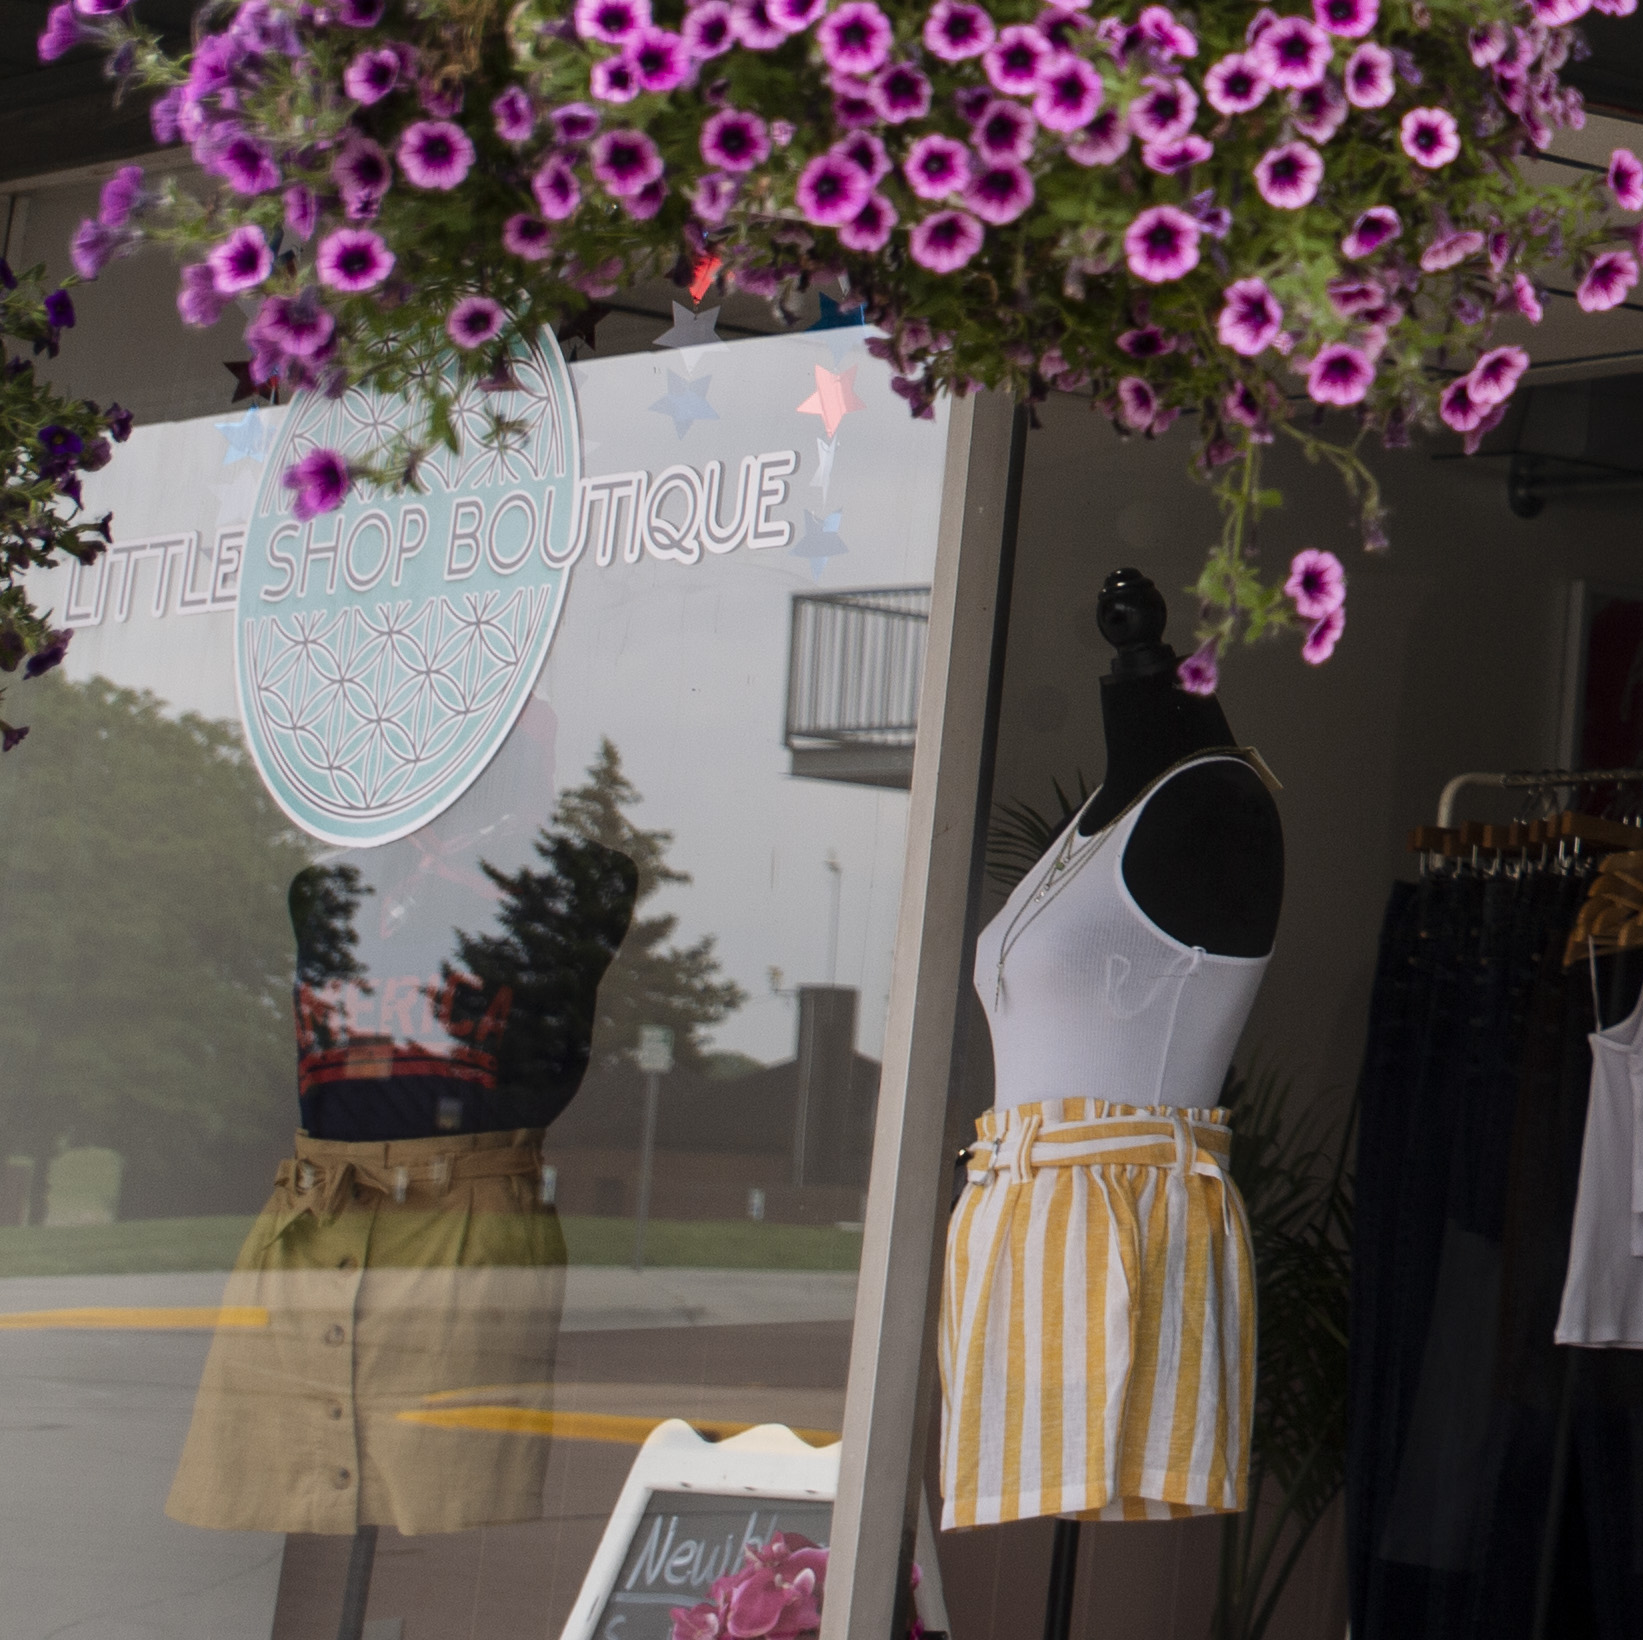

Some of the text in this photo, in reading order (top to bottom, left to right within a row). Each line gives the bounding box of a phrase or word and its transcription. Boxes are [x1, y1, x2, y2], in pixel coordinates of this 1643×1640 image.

[62, 449, 798, 629] LITTLE SHOP BOUTIQUE
[295, 971, 513, 1050] MERICA
